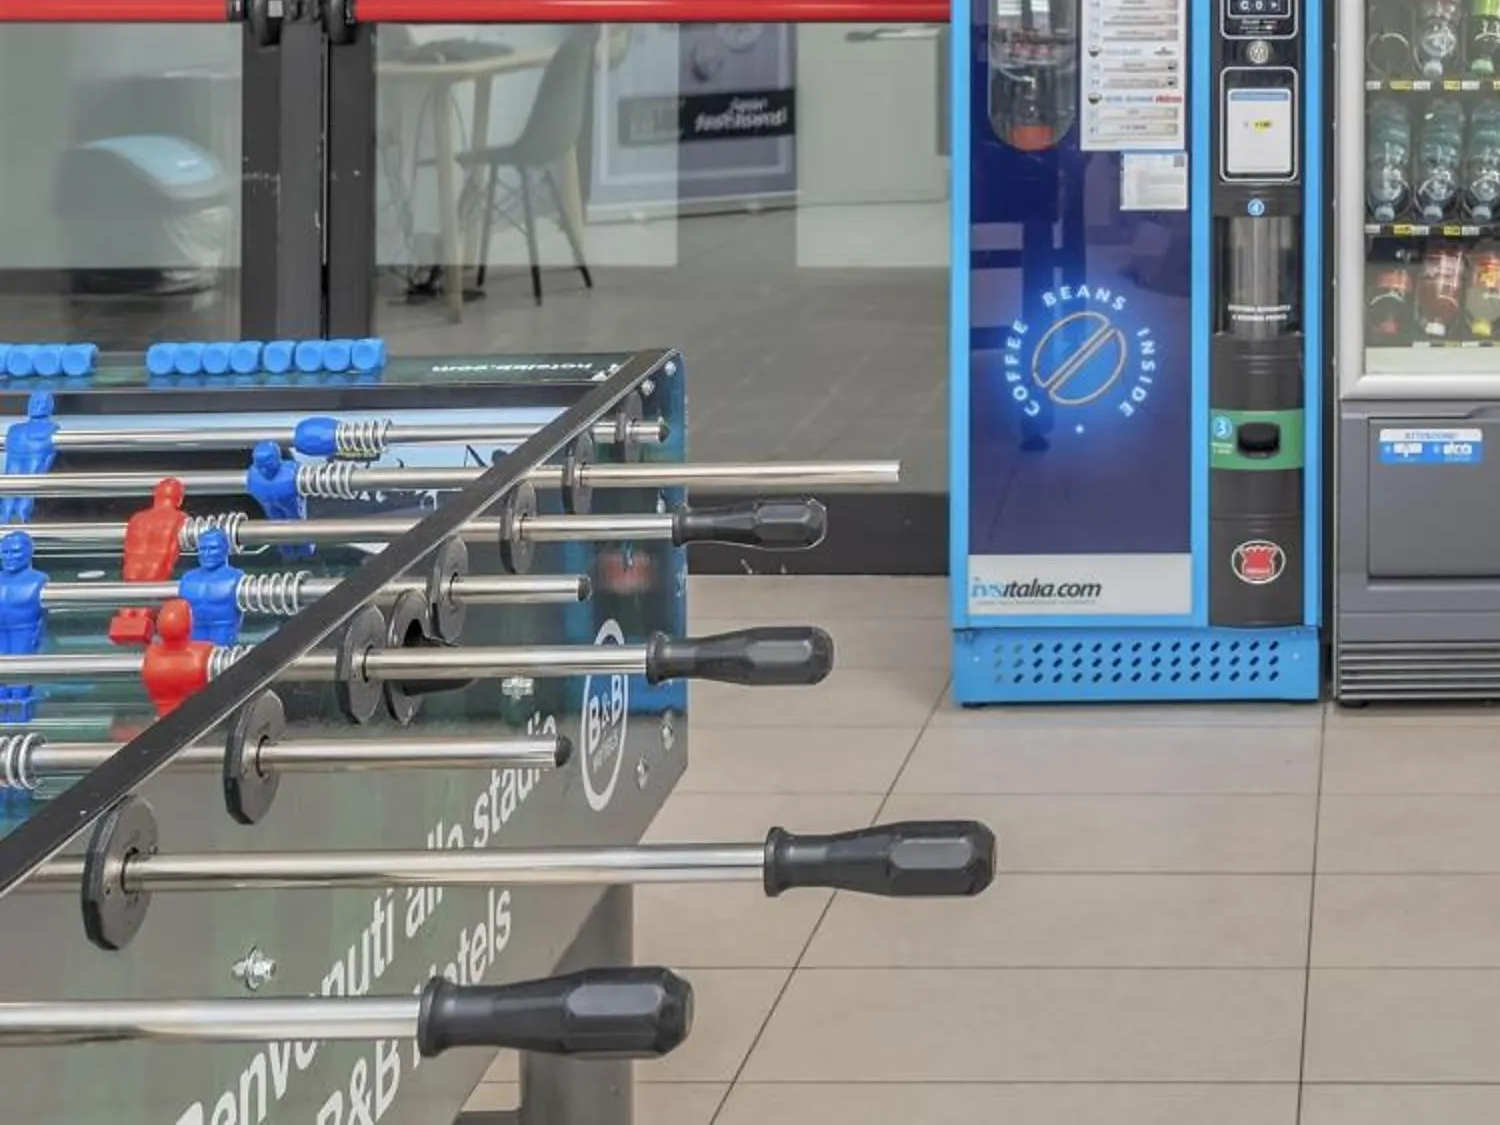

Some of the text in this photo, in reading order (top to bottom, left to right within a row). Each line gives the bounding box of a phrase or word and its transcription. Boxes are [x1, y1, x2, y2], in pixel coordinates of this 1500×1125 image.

[1042, 284, 1127, 311] BEANS
[1004, 319, 1041, 417] COFFEE
[1119, 327, 1156, 418] INSIDE
